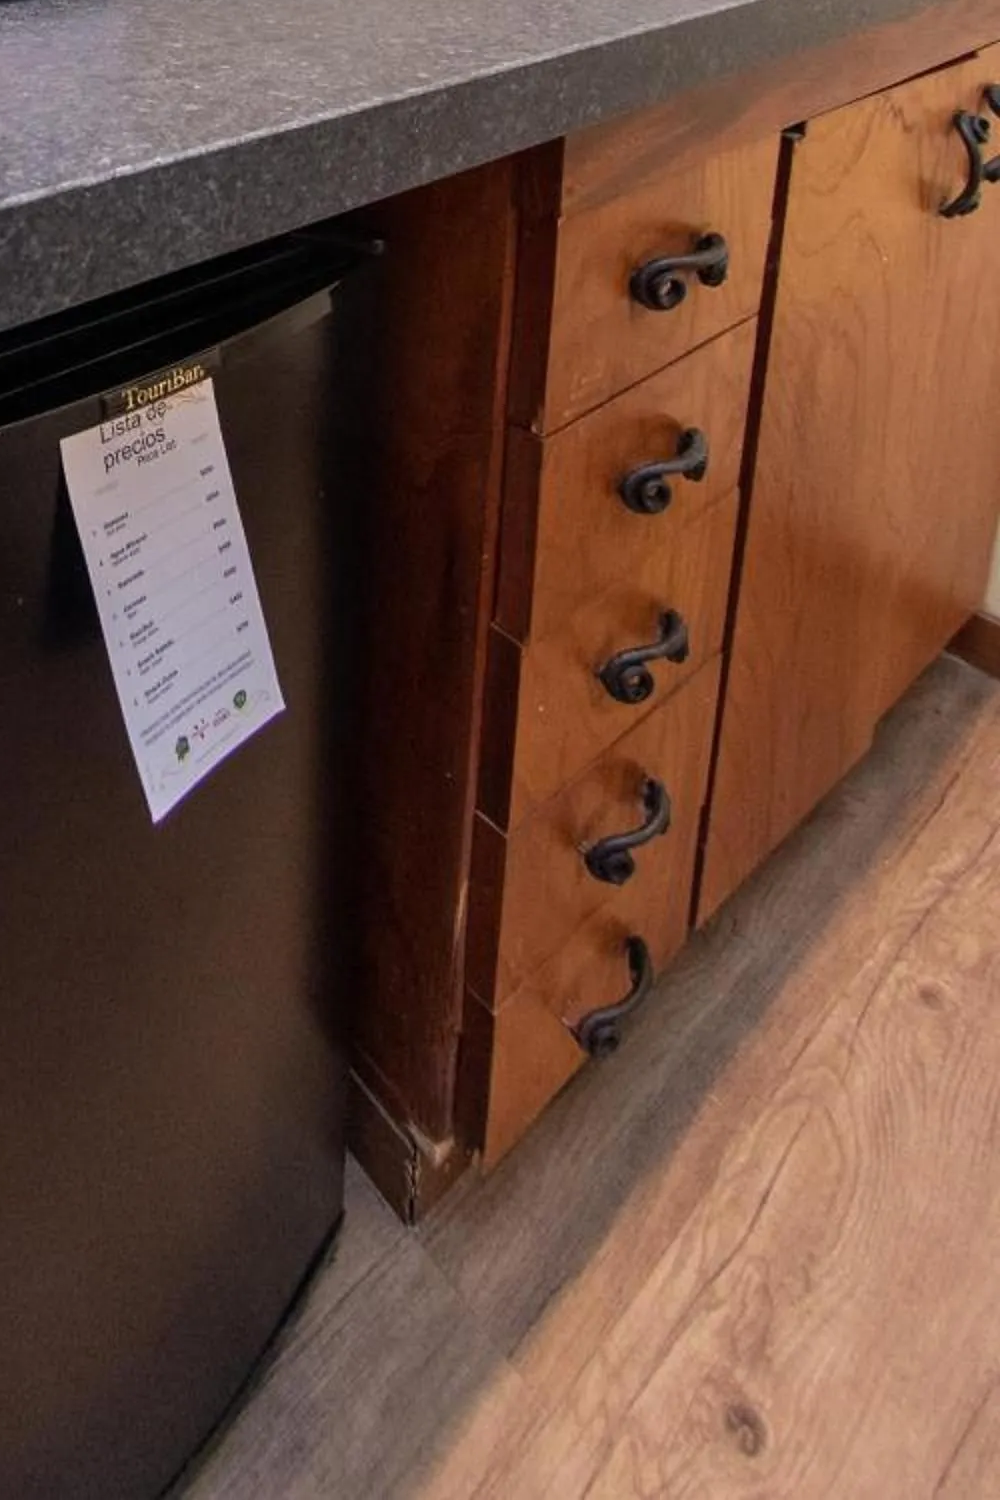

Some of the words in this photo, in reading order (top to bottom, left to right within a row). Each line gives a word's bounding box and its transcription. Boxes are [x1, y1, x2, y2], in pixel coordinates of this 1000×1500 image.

[121, 365, 202, 410] TouriBar
[100, 412, 141, 445] Lista
[145, 401, 167, 422] de
[103, 427, 166, 475] precios
